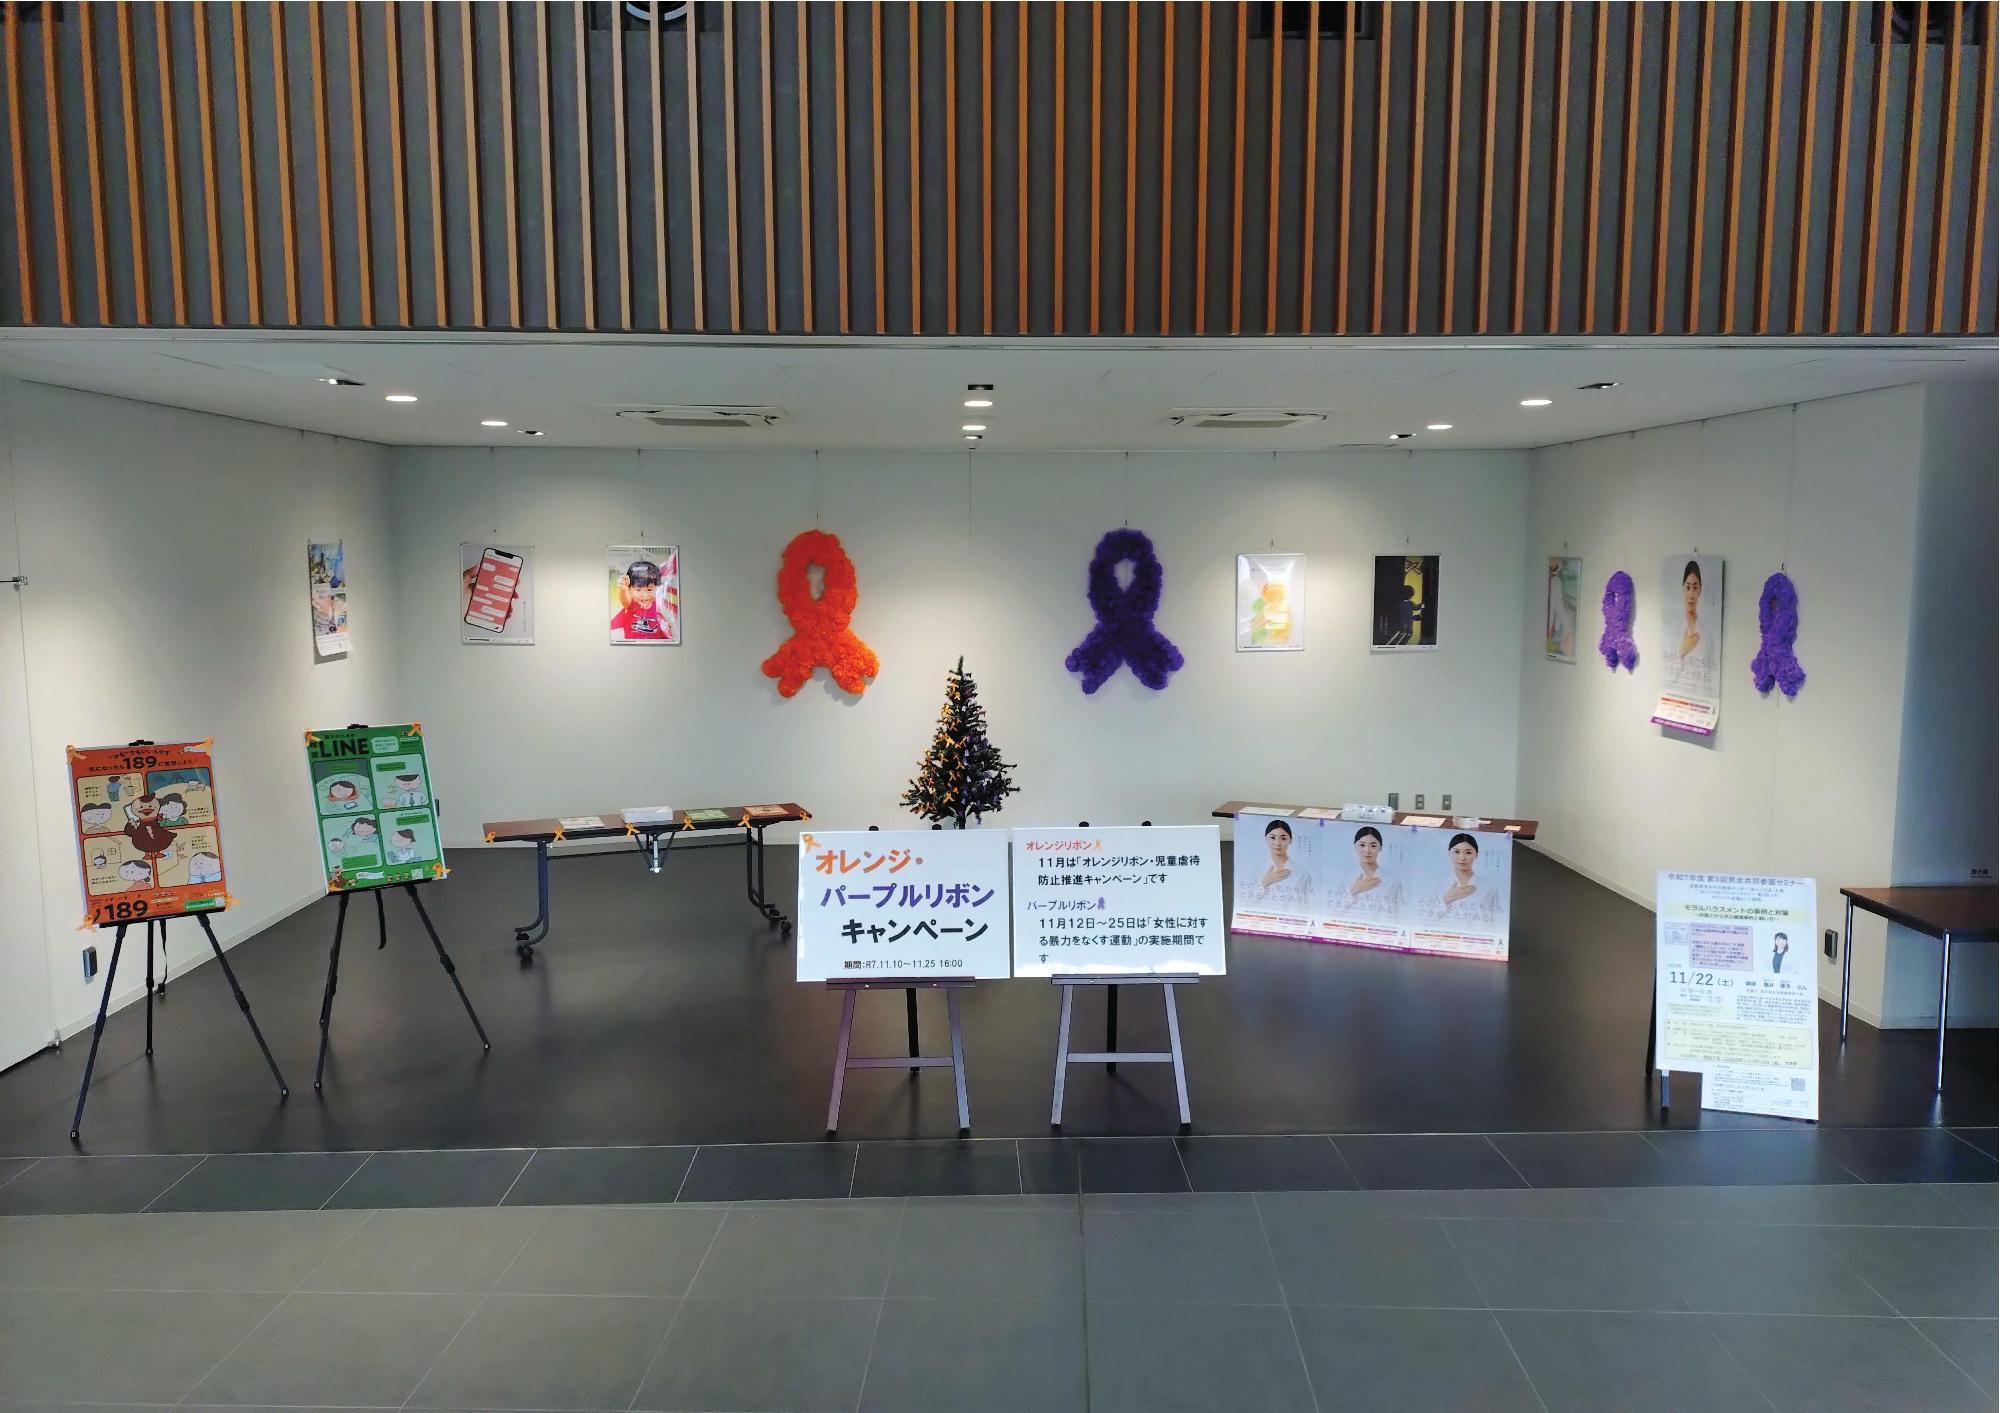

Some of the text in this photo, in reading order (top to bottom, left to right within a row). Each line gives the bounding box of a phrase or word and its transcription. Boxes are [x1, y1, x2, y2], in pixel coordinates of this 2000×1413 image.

[319, 738, 369, 757] LINE
[123, 756, 157, 769] 189
[1025, 840, 1093, 851] オレンジリボン
[1037, 873, 1169, 886] 防止推進キャンペーン」です
[819, 882, 995, 909] パープルリボン
[104, 899, 149, 921] 189
[841, 918, 989, 945] キャンペーン
[1038, 935, 1206, 947] る暴力をなくす運動」の実施期間で
[938, 959, 963, 968] 16:00
[1038, 953, 1050, 964] す
